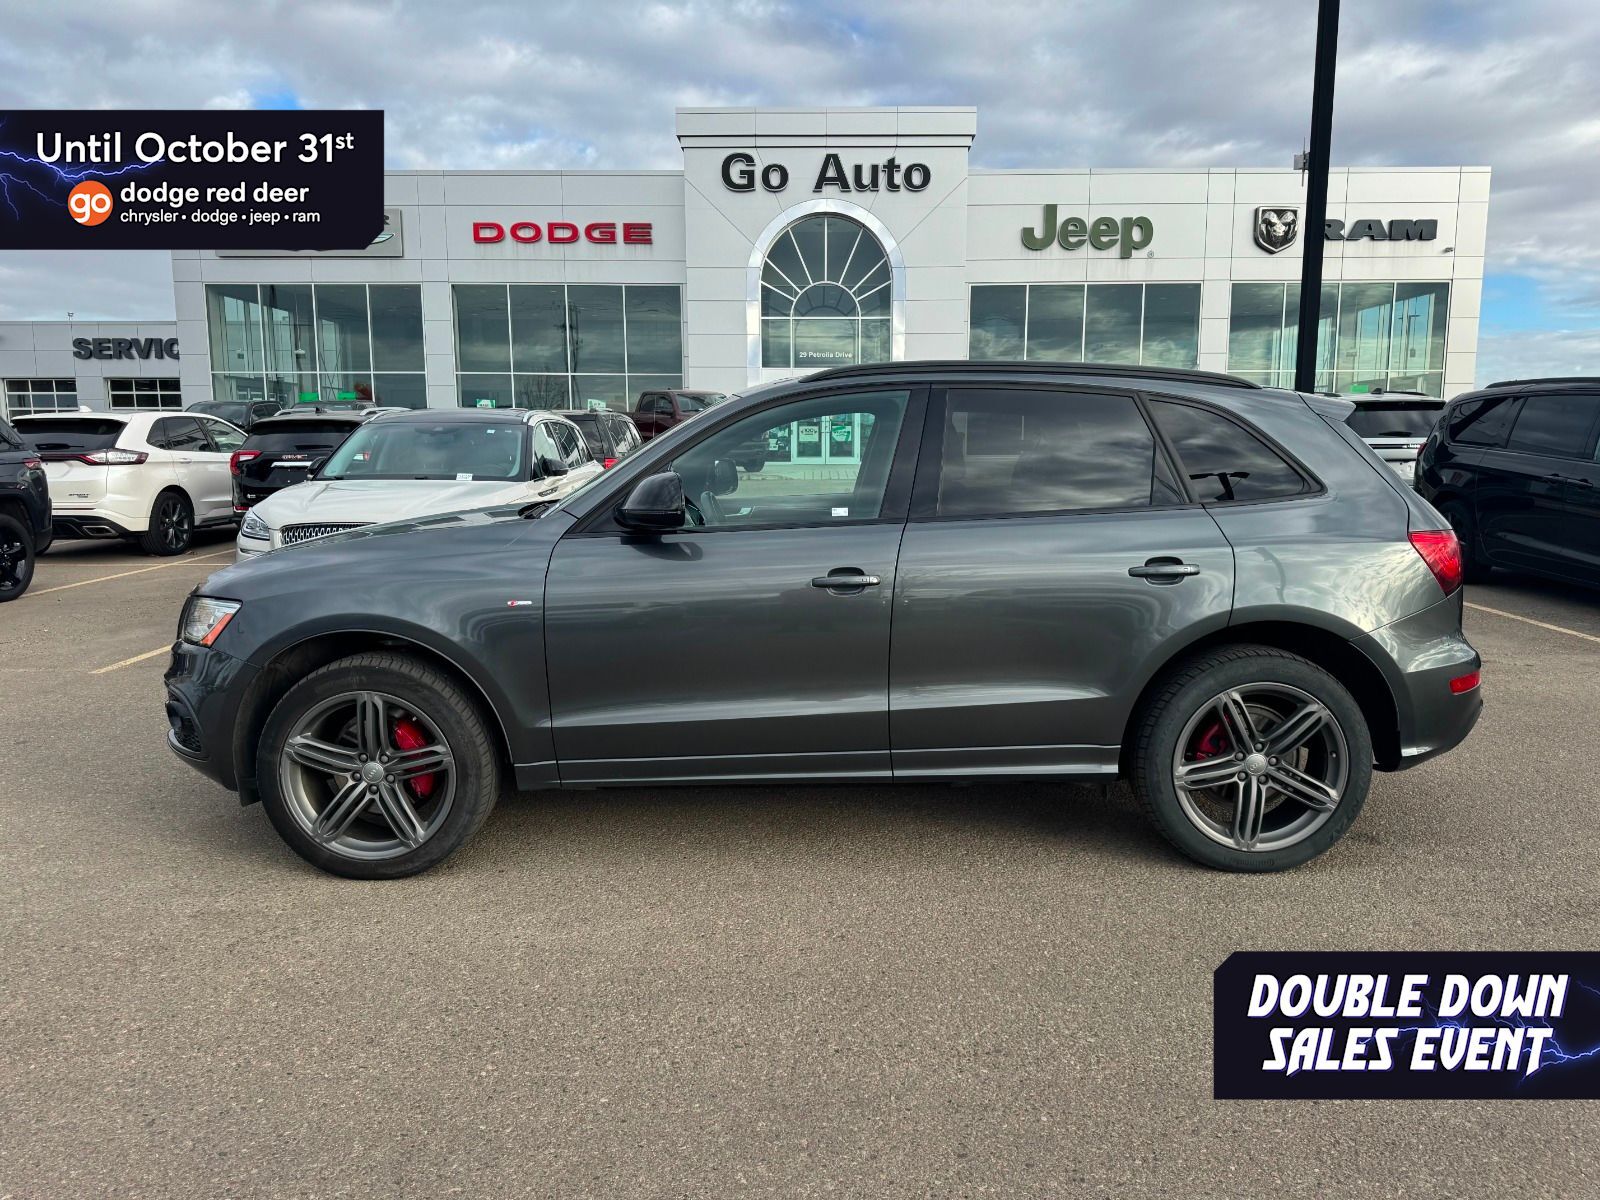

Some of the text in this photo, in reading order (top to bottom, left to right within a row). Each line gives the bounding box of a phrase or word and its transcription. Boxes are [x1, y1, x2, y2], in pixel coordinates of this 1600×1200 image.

[721, 152, 931, 192] Go Auto
[473, 222, 653, 245] DODGE
[1022, 204, 1153, 259] Jeep
